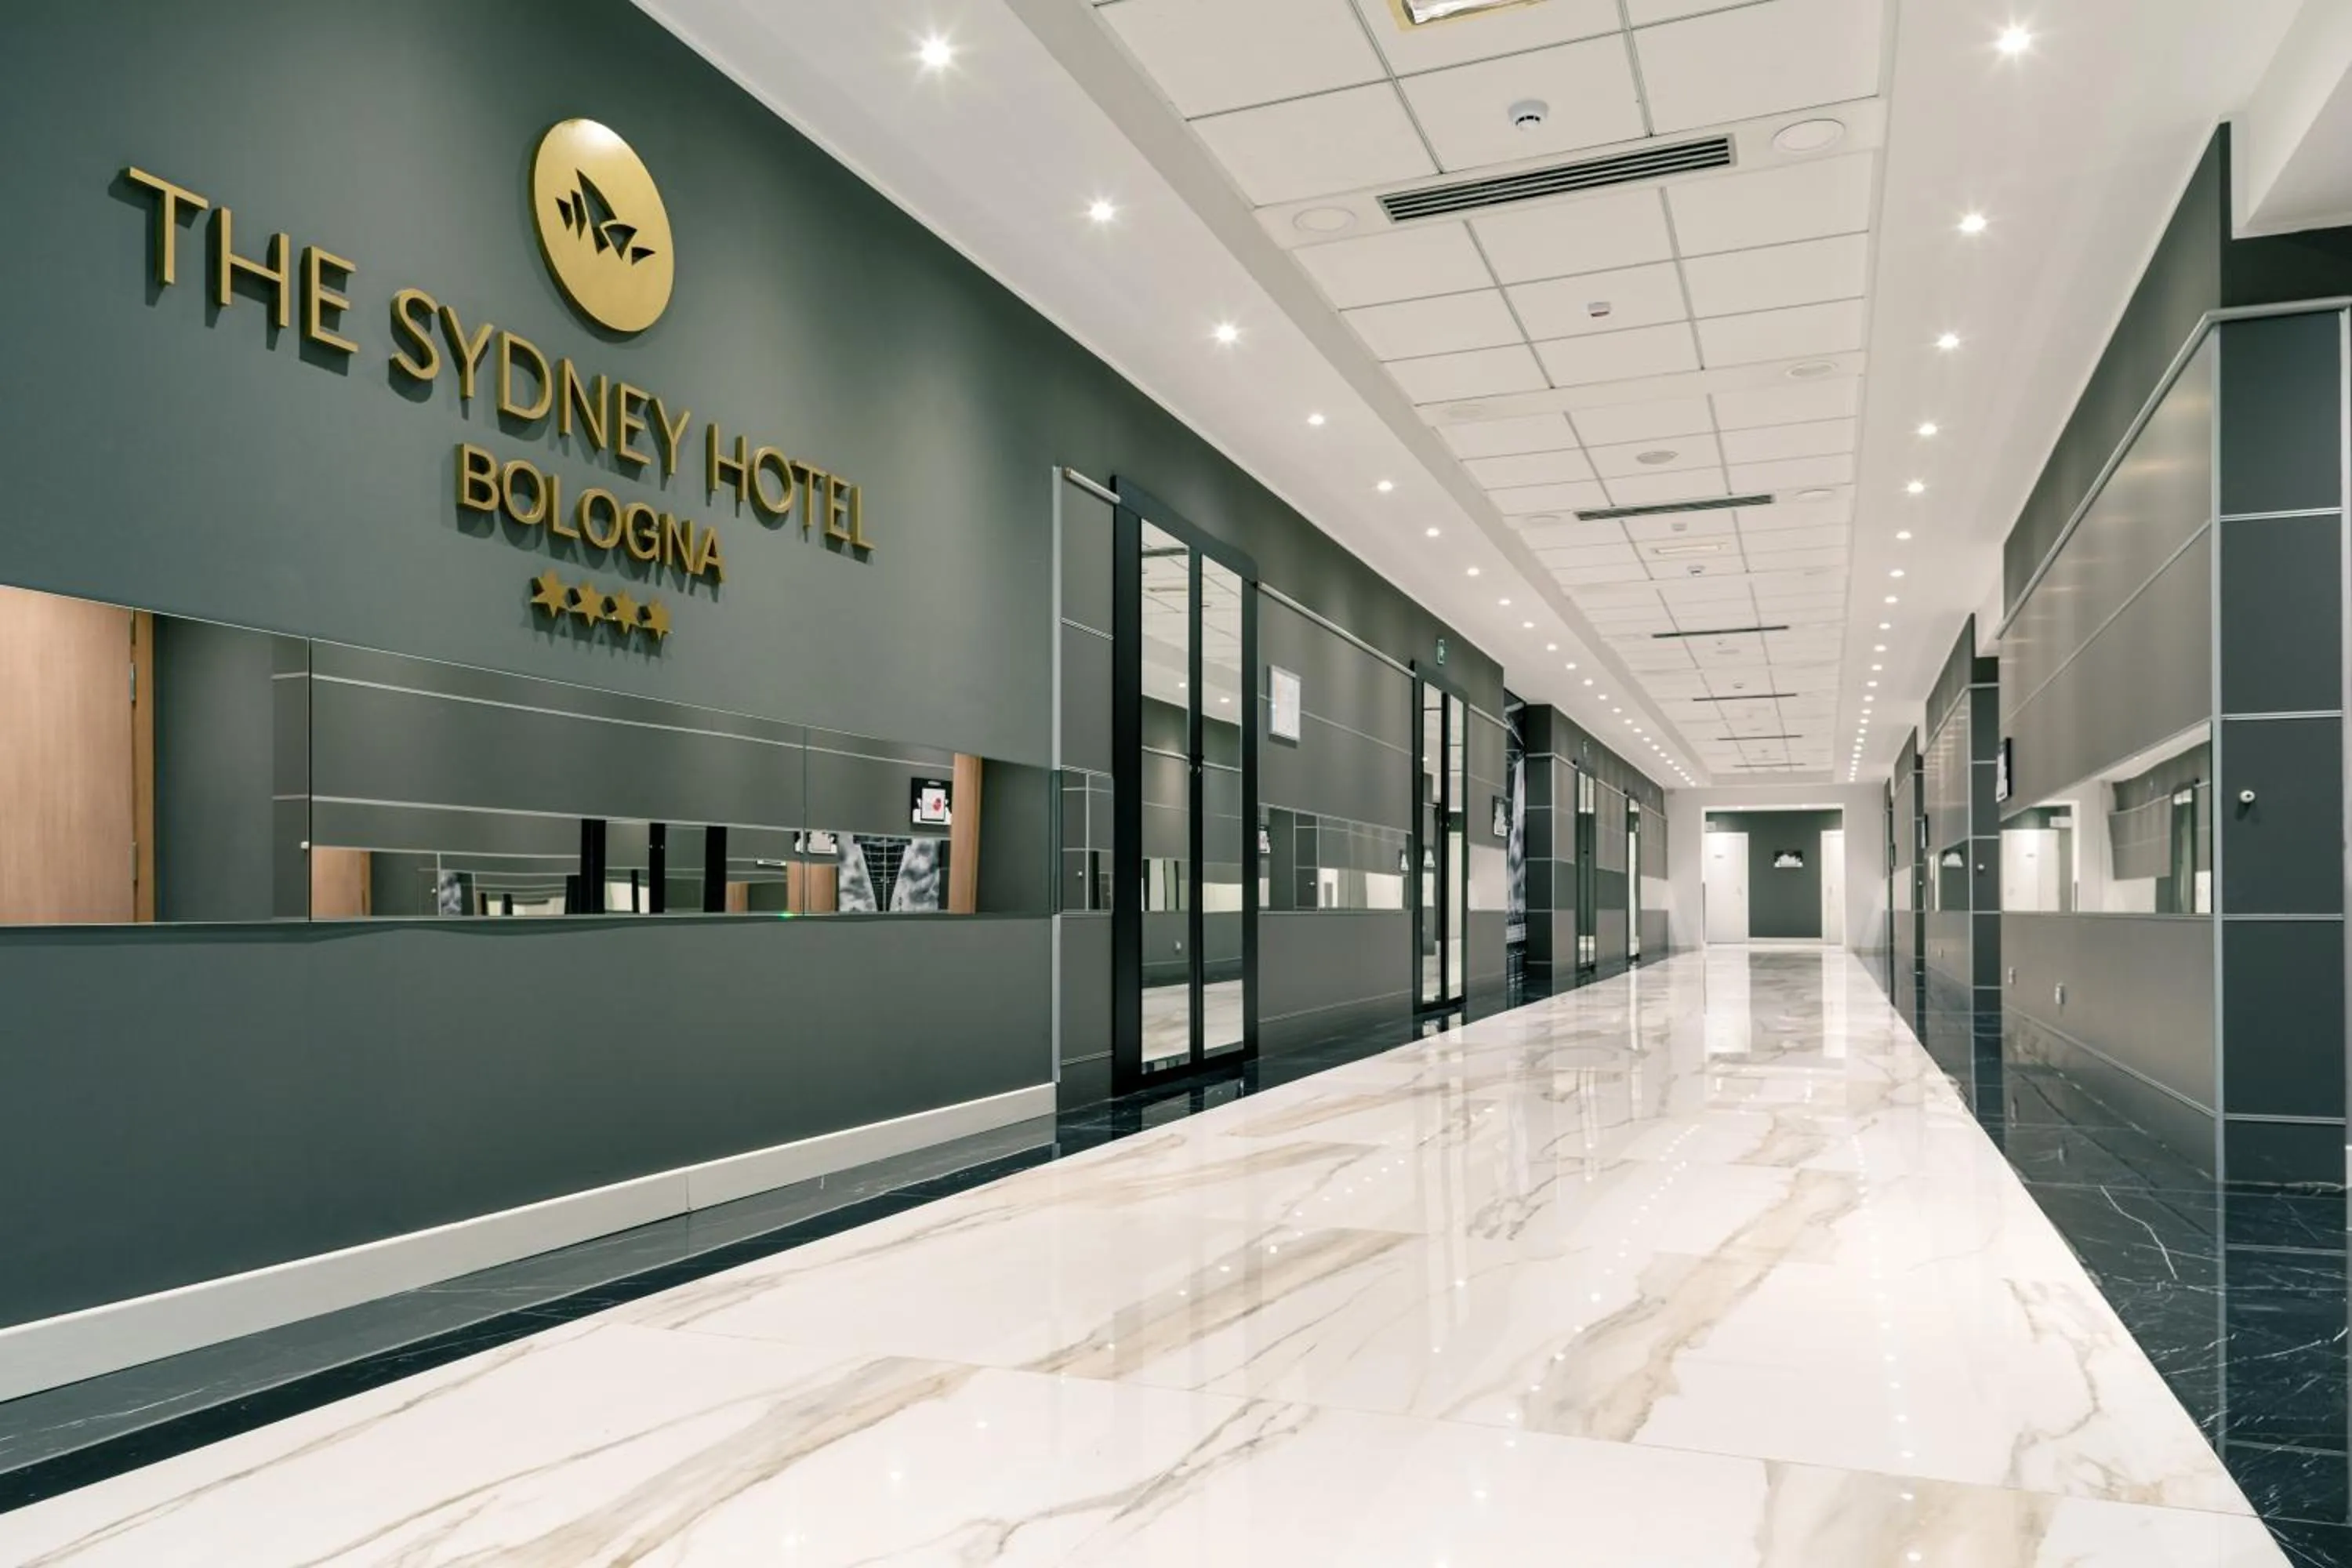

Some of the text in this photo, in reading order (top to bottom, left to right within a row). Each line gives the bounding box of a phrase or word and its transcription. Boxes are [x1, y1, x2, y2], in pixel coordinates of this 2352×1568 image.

[125, 165, 876, 550] THE SYDNEY HOTEL
[456, 443, 725, 583] BOLOGNA
